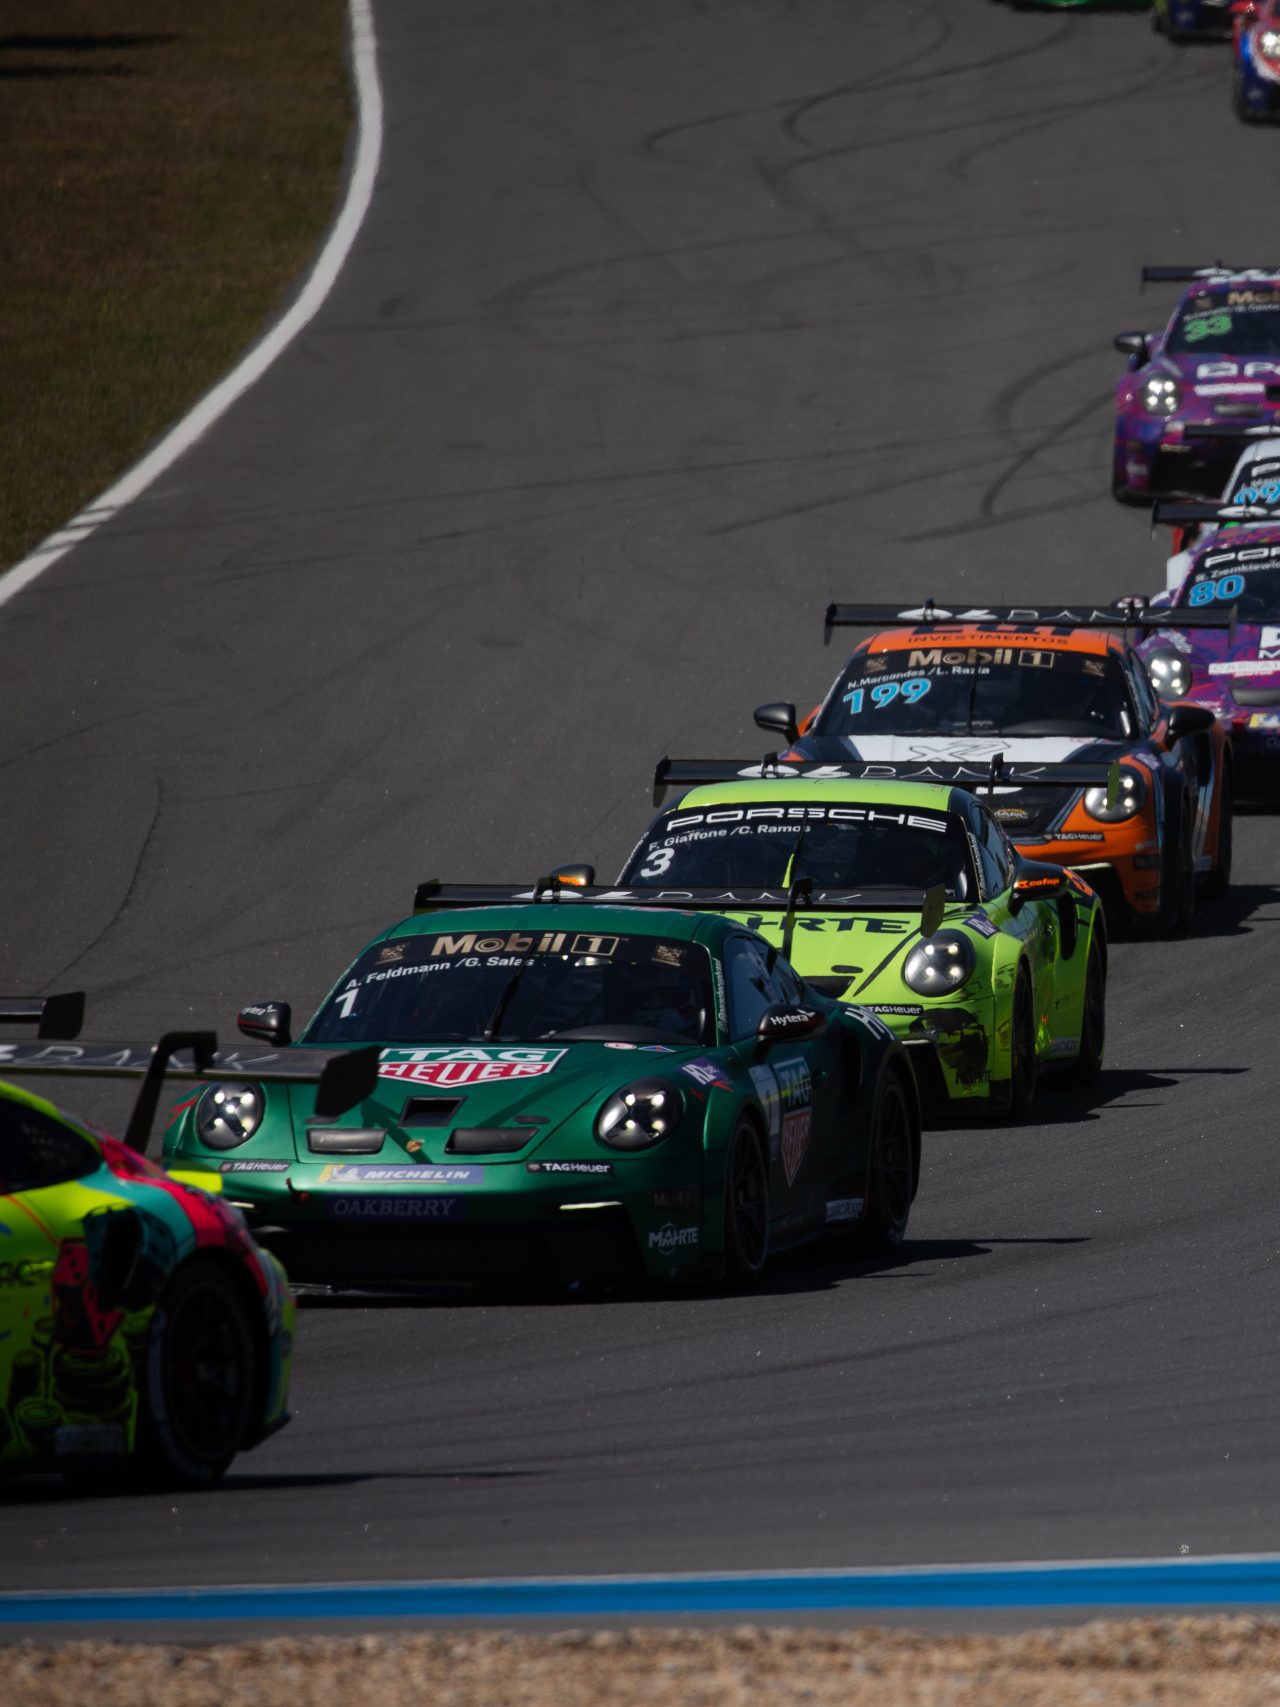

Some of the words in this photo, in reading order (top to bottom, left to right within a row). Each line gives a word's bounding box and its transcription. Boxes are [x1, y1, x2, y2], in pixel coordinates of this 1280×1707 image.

[1185, 316, 1233, 342] 33
[1189, 575, 1245, 607] 80
[908, 649, 1013, 668] Mobil
[842, 677, 932, 715] 199
[861, 766, 1046, 780] BANK
[666, 807, 948, 833] PORSCHE
[648, 841, 661, 853] F.
[664, 828, 728, 848] Giaffone
[758, 823, 811, 834] Ramos
[1053, 833, 1104, 843] TAGHeuer
[640, 848, 675, 879] 3
[431, 933, 566, 957] Mobil
[345, 977, 363, 991] A.
[366, 963, 450, 984] Feldmann
[486, 955, 534, 968] Salas
[334, 989, 360, 1019] 1
[868, 1004, 922, 1016] TAGHeuer
[770, 1013, 809, 1027] Hytera
[394, 1047, 546, 1063] TAG
[380, 1062, 546, 1087] HEUER
[231, 1160, 289, 1173] TAGHeuer
[364, 1168, 471, 1180] MICHELIN
[541, 1162, 612, 1174] TAGHeuer
[333, 1198, 456, 1217] OAKBERRY
